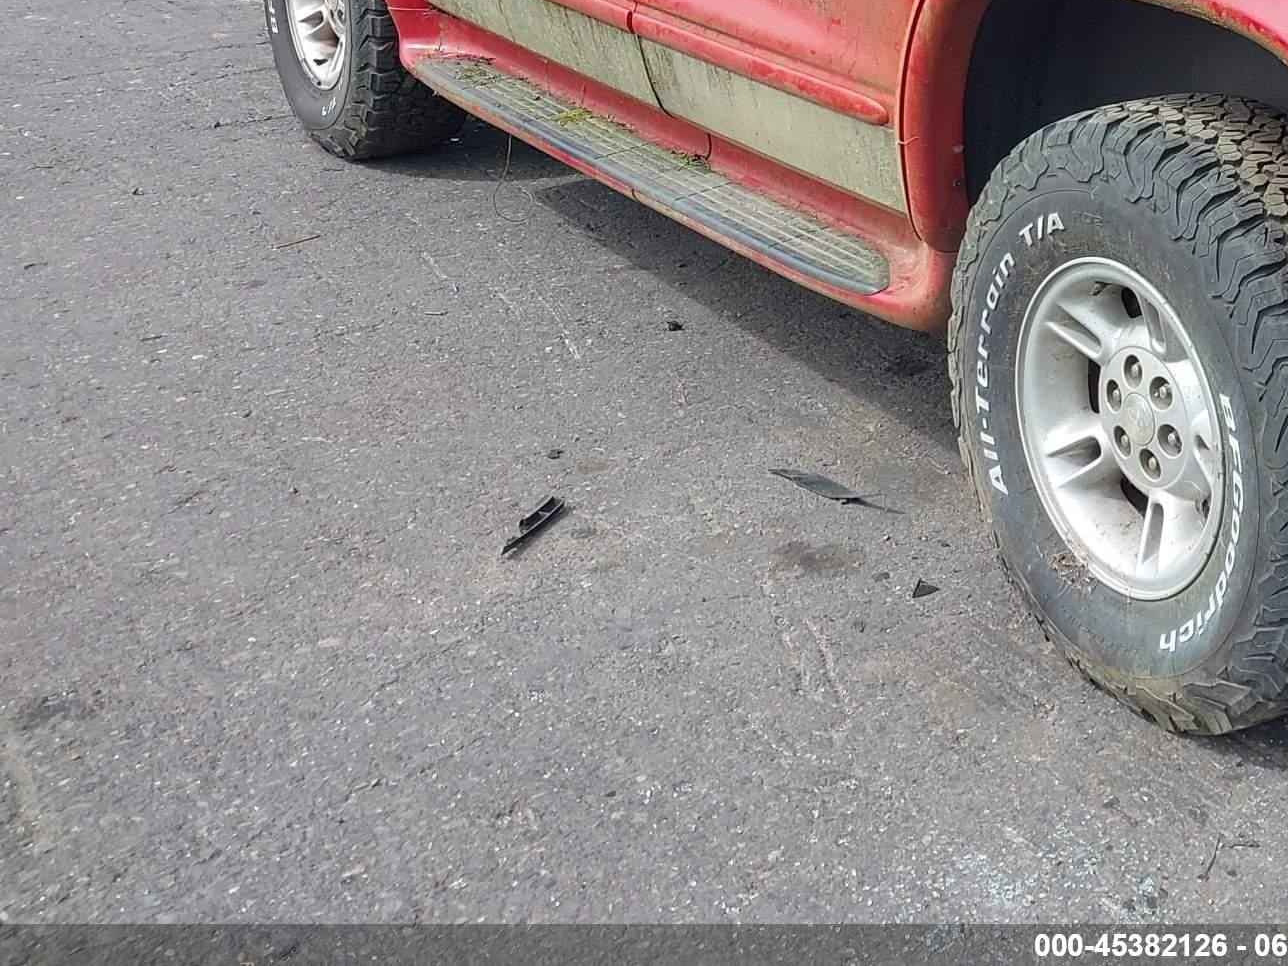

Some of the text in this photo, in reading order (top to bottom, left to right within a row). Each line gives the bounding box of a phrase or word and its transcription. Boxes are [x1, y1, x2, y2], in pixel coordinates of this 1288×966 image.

[974, 211, 1067, 496] All-Terrain T/A
[1159, 392, 1244, 653] BFGoodrich
